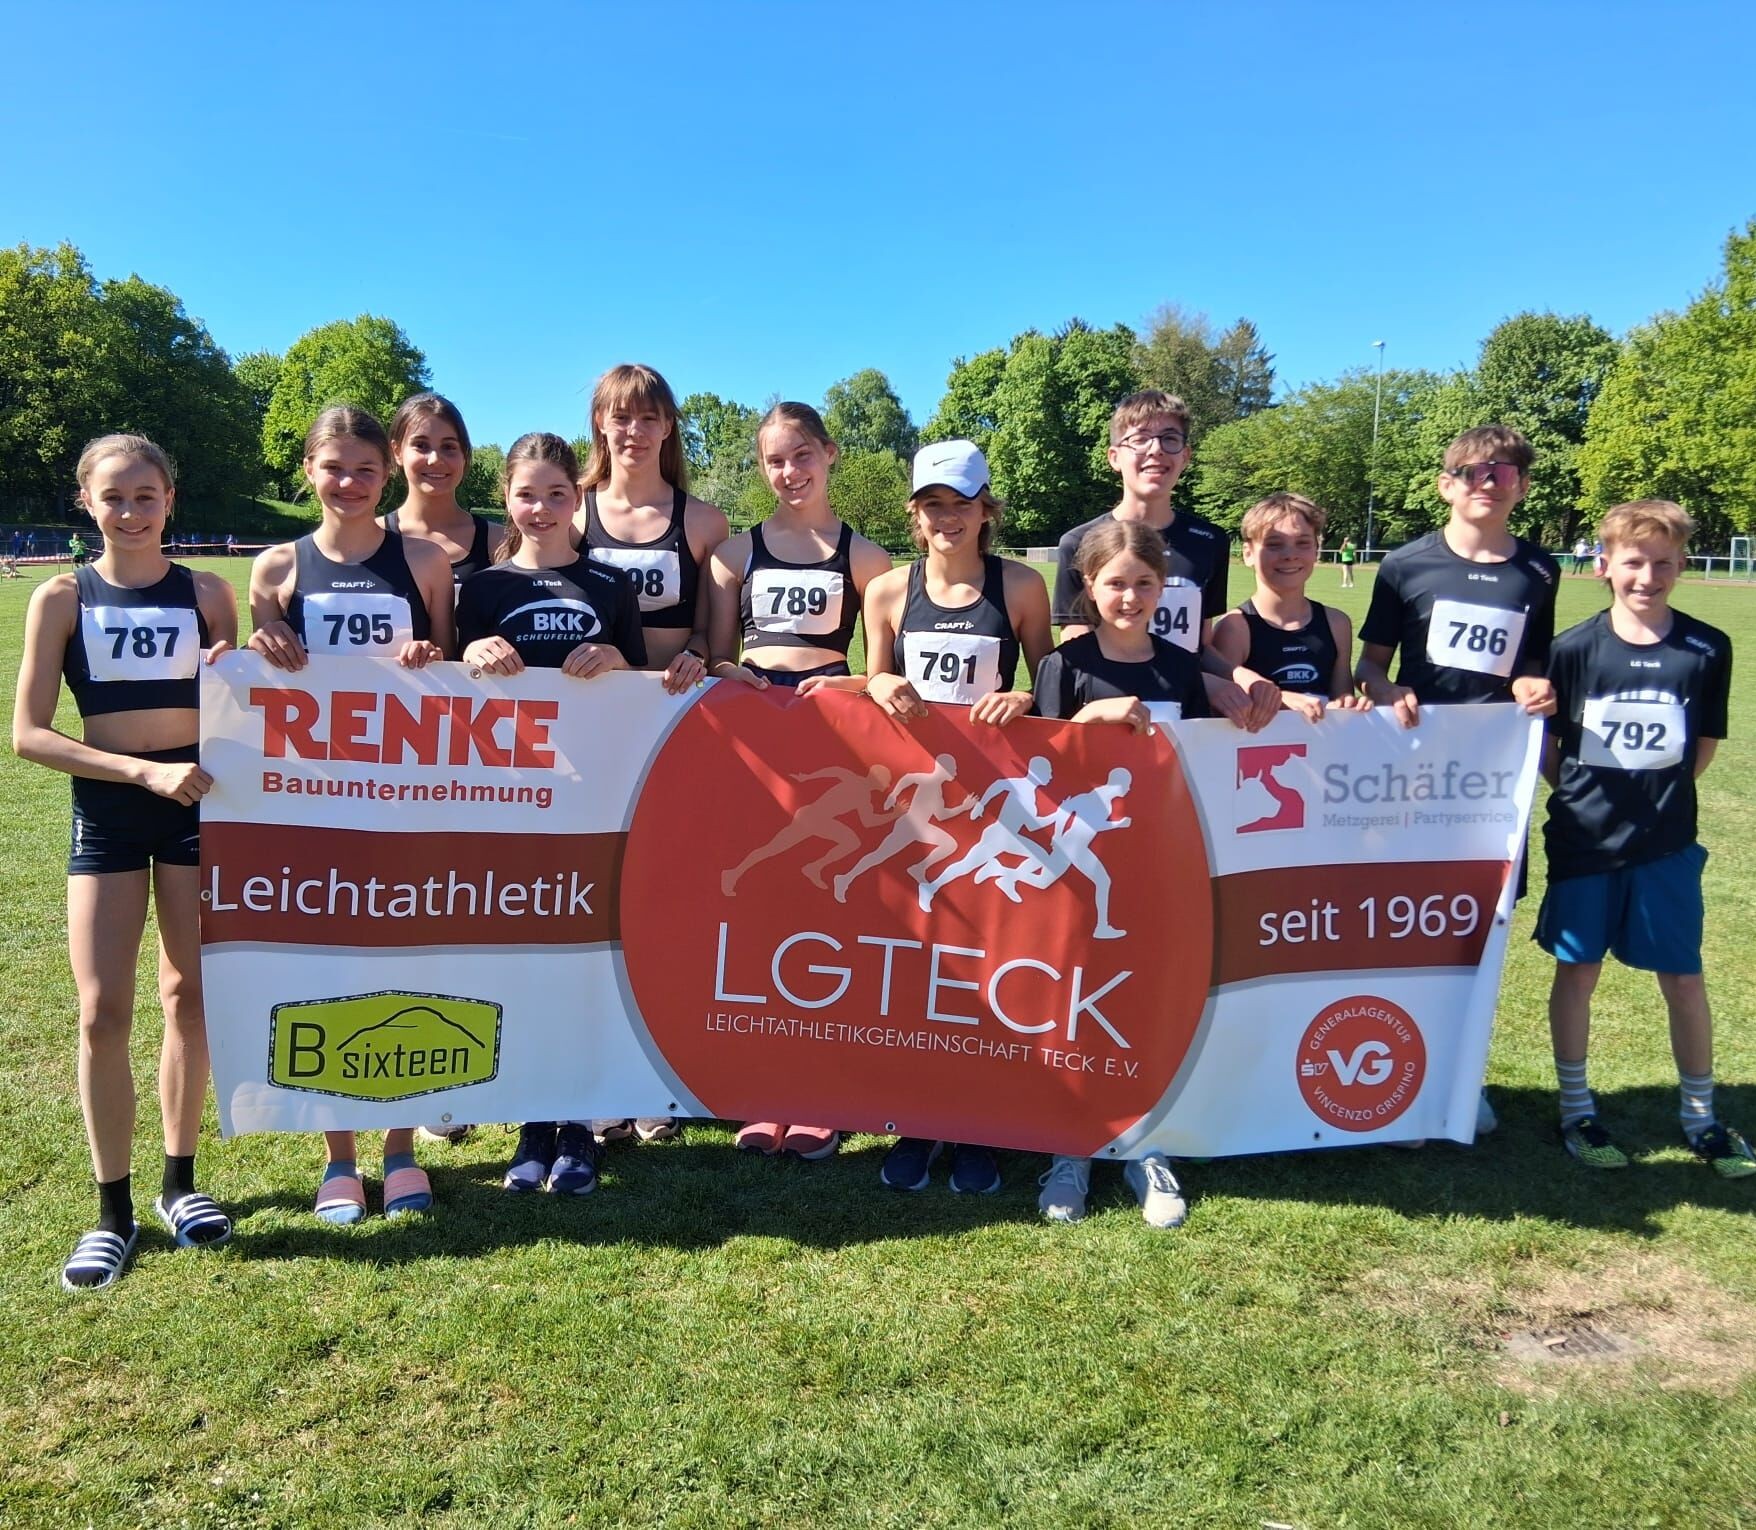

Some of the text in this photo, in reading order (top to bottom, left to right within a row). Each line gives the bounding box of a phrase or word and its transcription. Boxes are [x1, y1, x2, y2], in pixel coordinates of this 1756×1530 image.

[331, 581, 366, 589] CRAFT
[767, 586, 828, 616] 789
[323, 613, 394, 646] 795
[515, 633, 584, 642] SCHEUFELEN
[533, 613, 584, 632] BKK
[934, 622, 965, 630] CRAFT
[1448, 621, 1509, 657] 786
[104, 626, 180, 660] 787
[920, 651, 977, 685] 791
[1286, 670, 1310, 680] BKK
[249, 687, 560, 769] RENKE
[1602, 721, 1667, 751] 792
[262, 771, 553, 809] Bauunternehmung
[1322, 761, 1514, 804] Schäfer
[1322, 810, 1514, 829] Metzgerei Partyservice
[211, 865, 595, 918] Leichtathletik
[1258, 893, 1480, 946] seit 1969
[1309, 1006, 1412, 1050] GENERALAGENTUR
[288, 1022, 469, 1079] B sixteen
[705, 1012, 1140, 1080] LEICHTATHLETIKGEMEINSCHAFT TECK E.V.
[1326, 1040, 1394, 1086] VG
[1313, 1061, 1416, 1121] VINCENZO GRISPINO
